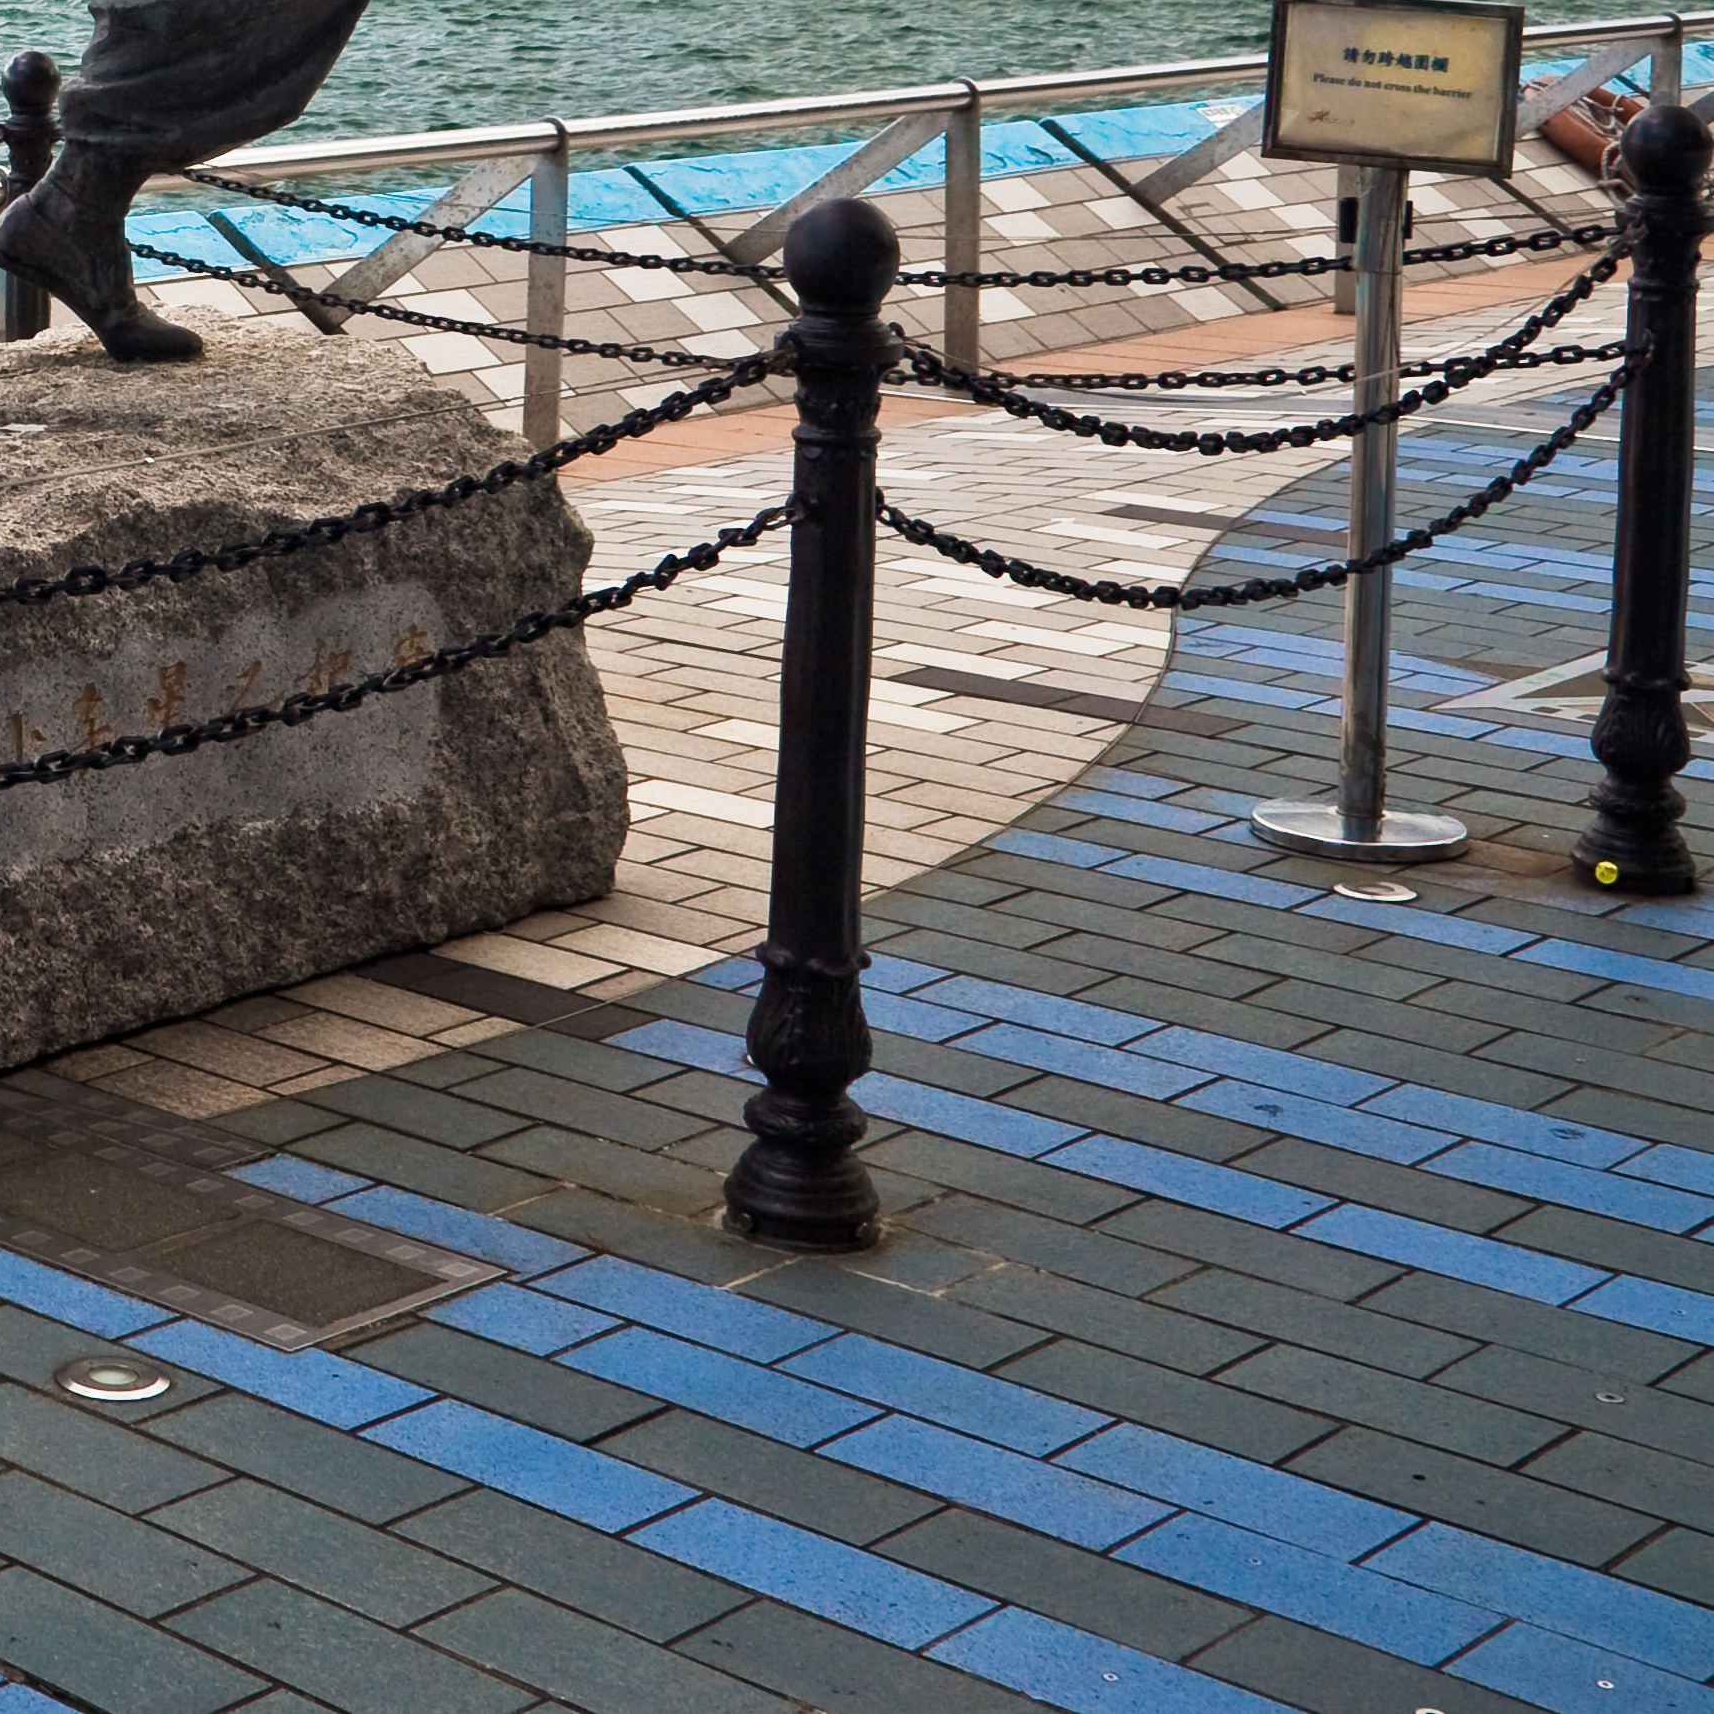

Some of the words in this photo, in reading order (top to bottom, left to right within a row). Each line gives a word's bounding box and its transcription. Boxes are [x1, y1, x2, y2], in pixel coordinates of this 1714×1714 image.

[1313, 73, 1346, 86] Please
[1347, 77, 1362, 88] do
[1363, 80, 1382, 91] not
[1383, 83, 1412, 93] cross
[1413, 84, 1431, 95] the
[1433, 86, 1472, 99] barrier
